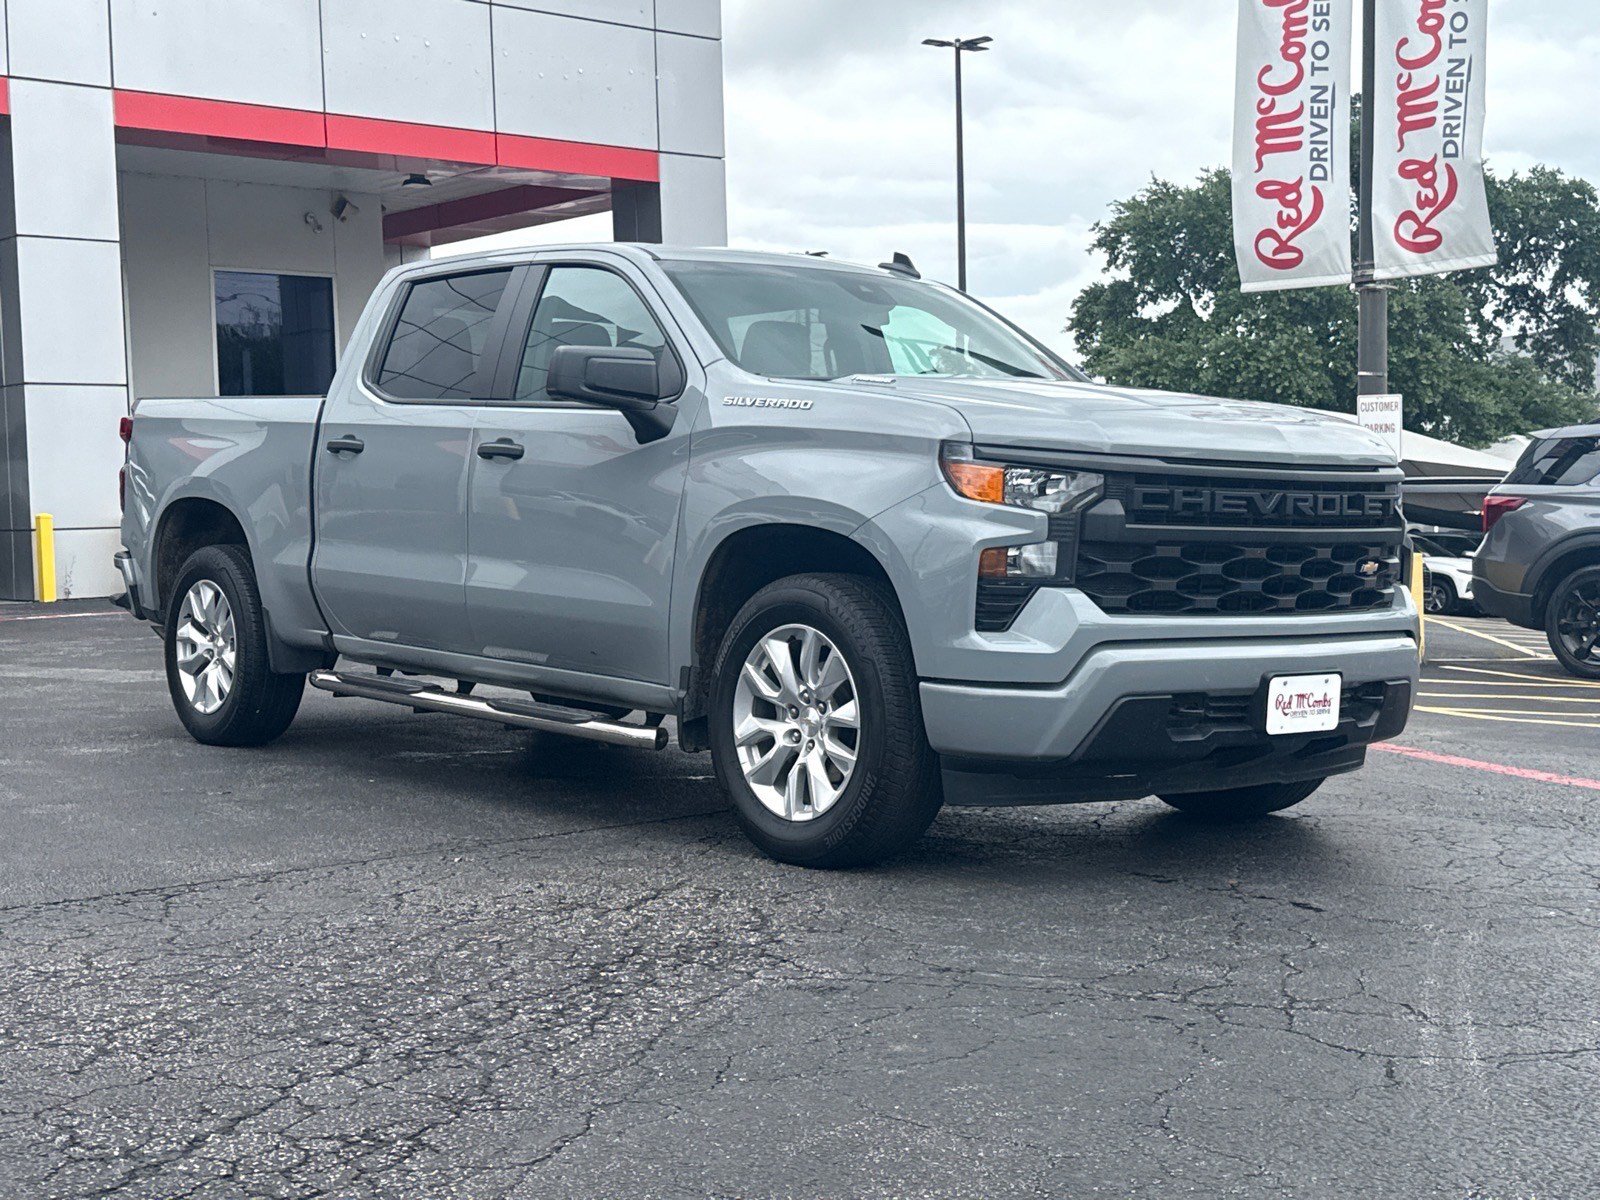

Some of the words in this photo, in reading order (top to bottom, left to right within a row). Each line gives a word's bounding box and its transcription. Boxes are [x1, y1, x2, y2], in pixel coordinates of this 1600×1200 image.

[1312, 0, 1331, 33] SE
[1449, 11, 1468, 49] TO
[1310, 40, 1330, 77] TO
[1442, 58, 1465, 158] DRIVEN
[1309, 85, 1329, 182] DRIVEN
[1394, 153, 1458, 254] Red
[1254, 176, 1324, 270] Red
[722, 396, 814, 411] SILVERADO
[1360, 401, 1399, 412] CUSTOMER
[1275, 693, 1293, 716] Red
[1294, 692, 1333, 708] McCombs
[824, 771, 878, 849] BRIDGESTONE
